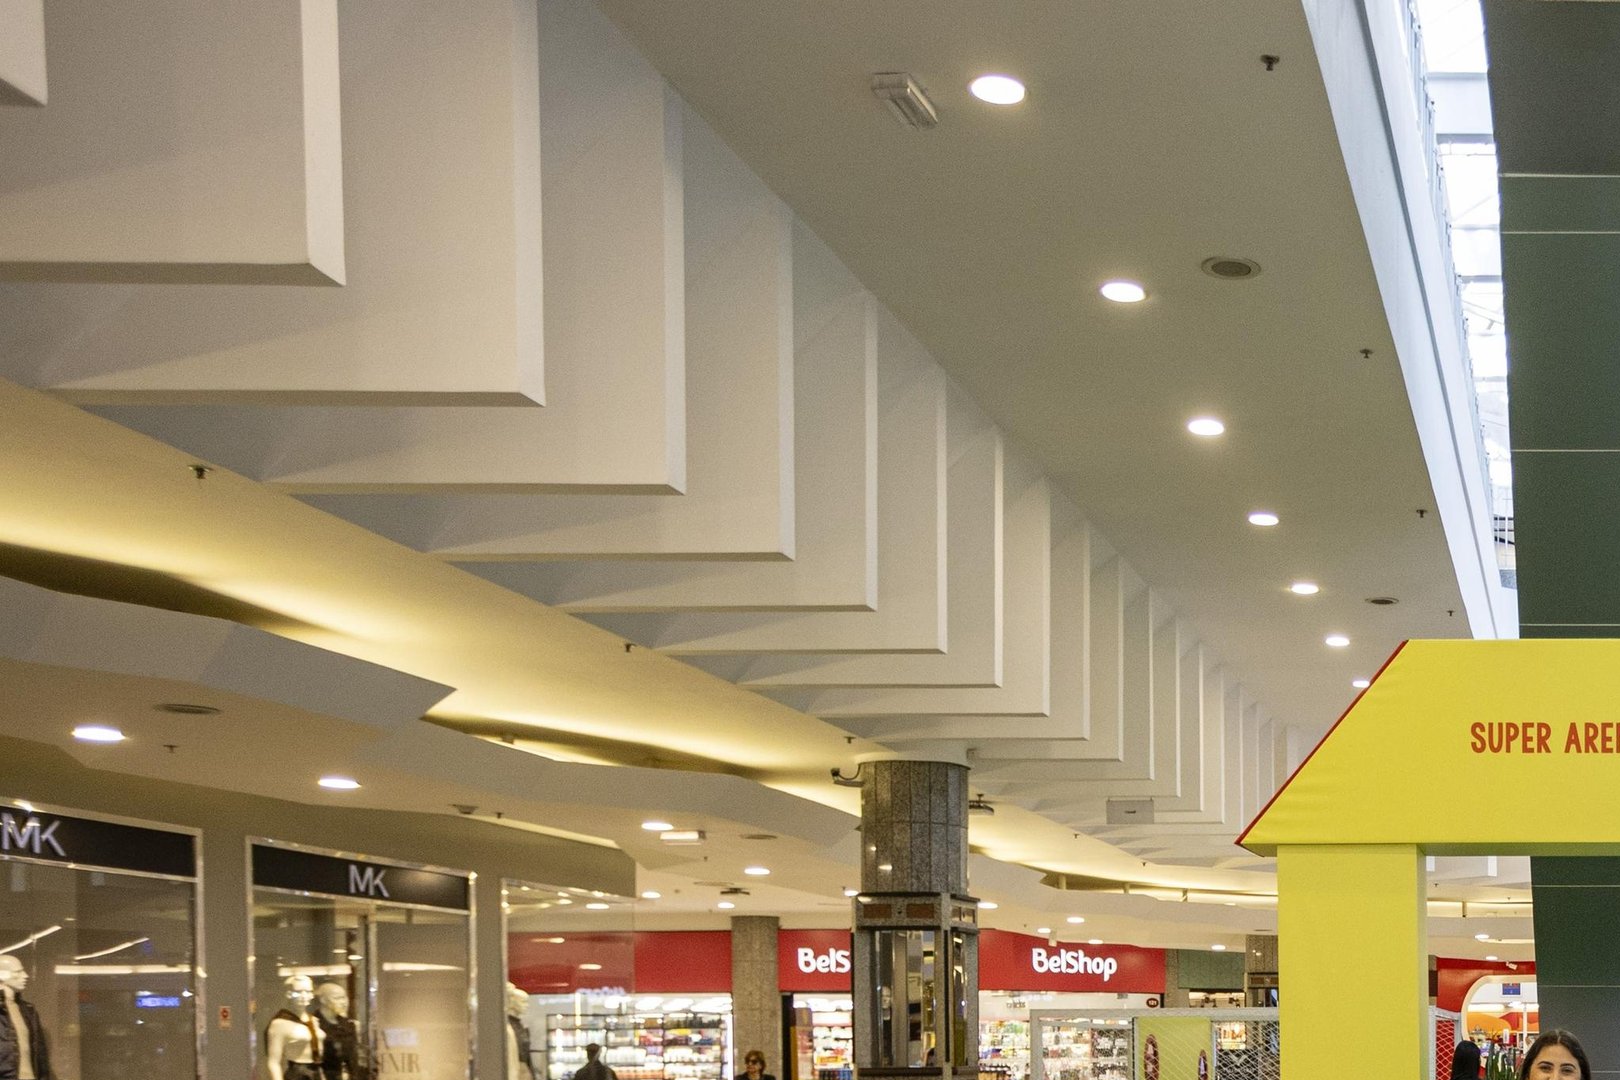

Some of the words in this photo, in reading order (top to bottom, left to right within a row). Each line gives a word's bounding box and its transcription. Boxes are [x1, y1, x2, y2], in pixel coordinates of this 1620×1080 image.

[1470, 721, 1551, 754] SUPER
[1, 811, 66, 857] MK
[349, 864, 390, 898] MK
[1031, 947, 1118, 982] BelShop
